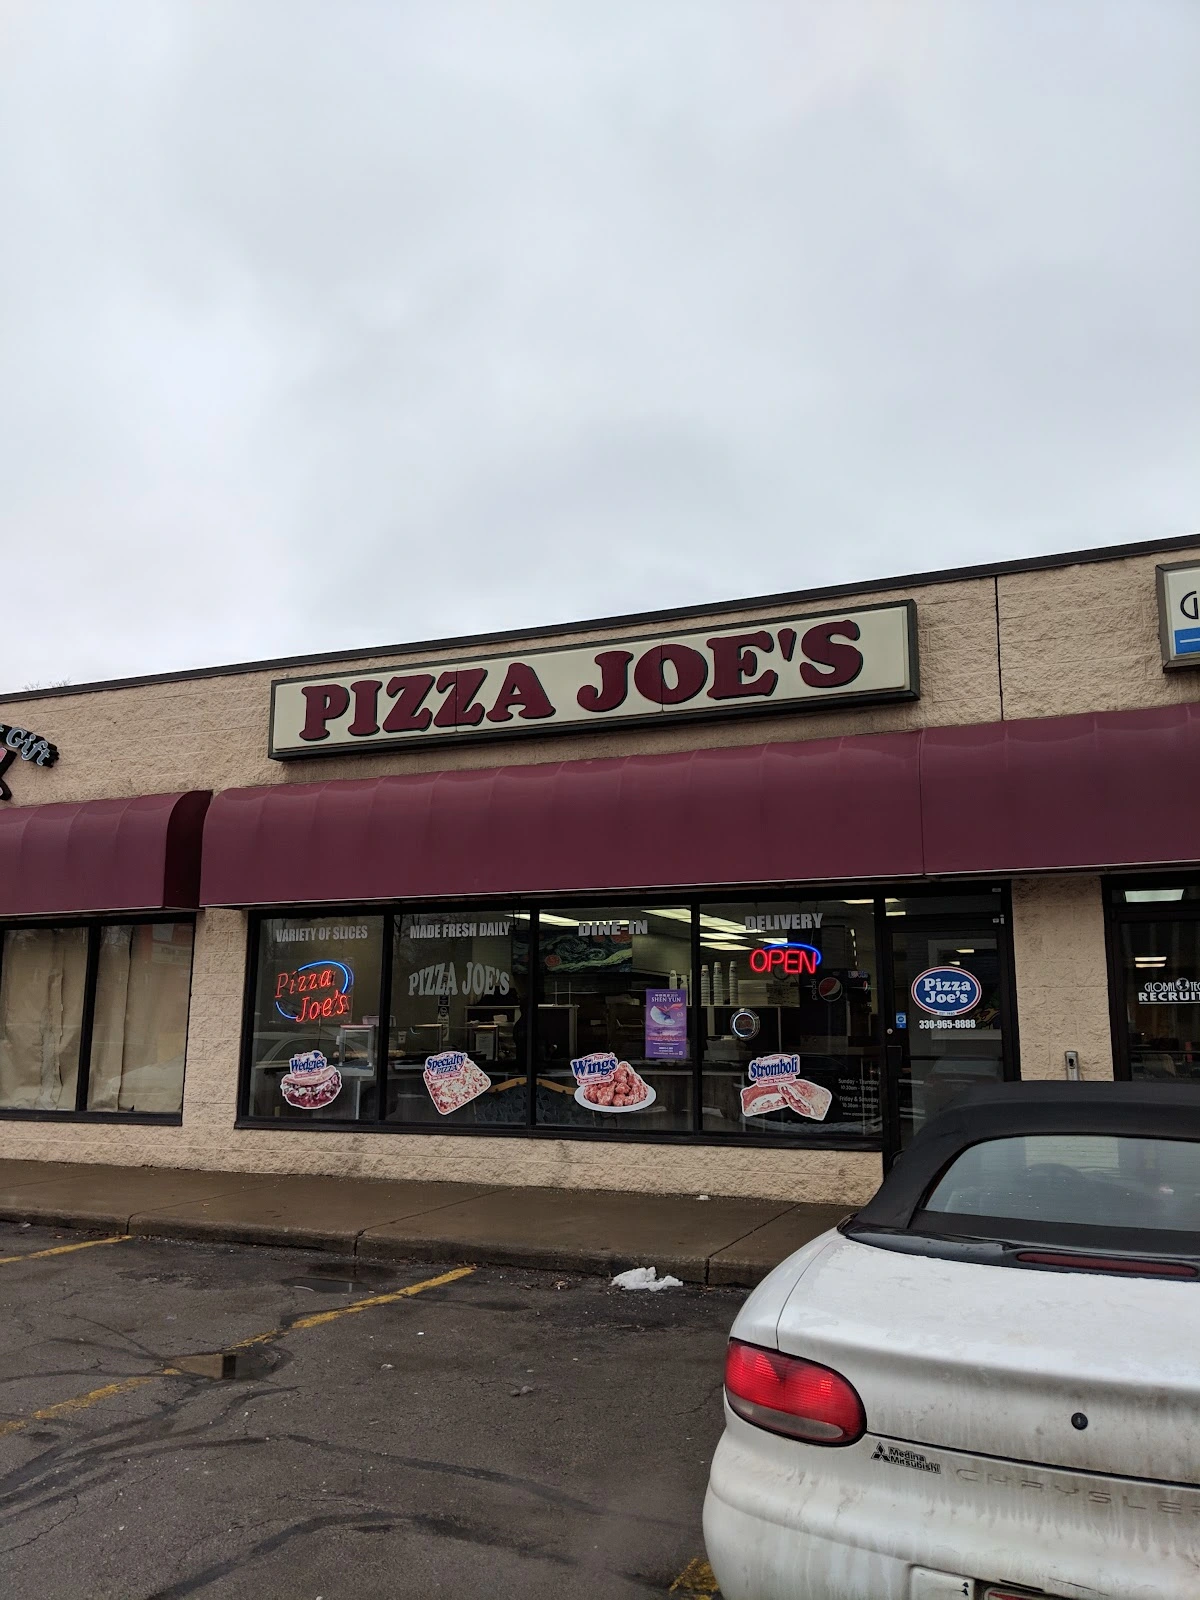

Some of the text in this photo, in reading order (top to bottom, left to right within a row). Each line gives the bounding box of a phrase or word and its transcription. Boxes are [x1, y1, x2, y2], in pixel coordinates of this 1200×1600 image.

[299, 619, 863, 741] PIZZA JOE'S
[6, 727, 51, 767] Gift
[410, 921, 510, 939] MADE FRESH DAILY
[578, 920, 648, 937] DINE-IN
[744, 913, 823, 930] DELIVERY
[276, 925, 368, 943] VARIETY OF SLICES
[750, 948, 817, 975] OPEN
[275, 970, 333, 998] Pizza
[408, 961, 510, 996] PIZZA JOE'S
[923, 978, 972, 992] Pizza
[1144, 981, 1177, 992] GLOBAL
[296, 989, 348, 1022] Joe's
[925, 991, 969, 1004] Joe's
[919, 1019, 977, 1029] 330-965-8888
[291, 1057, 326, 1073] Wedgies
[427, 1053, 464, 1071] Specialty
[572, 1059, 616, 1076] Wings
[750, 1056, 798, 1079] Stromboli
[888, 1447, 926, 1462] Medina
[889, 1455, 942, 1474] Mitsubishi
